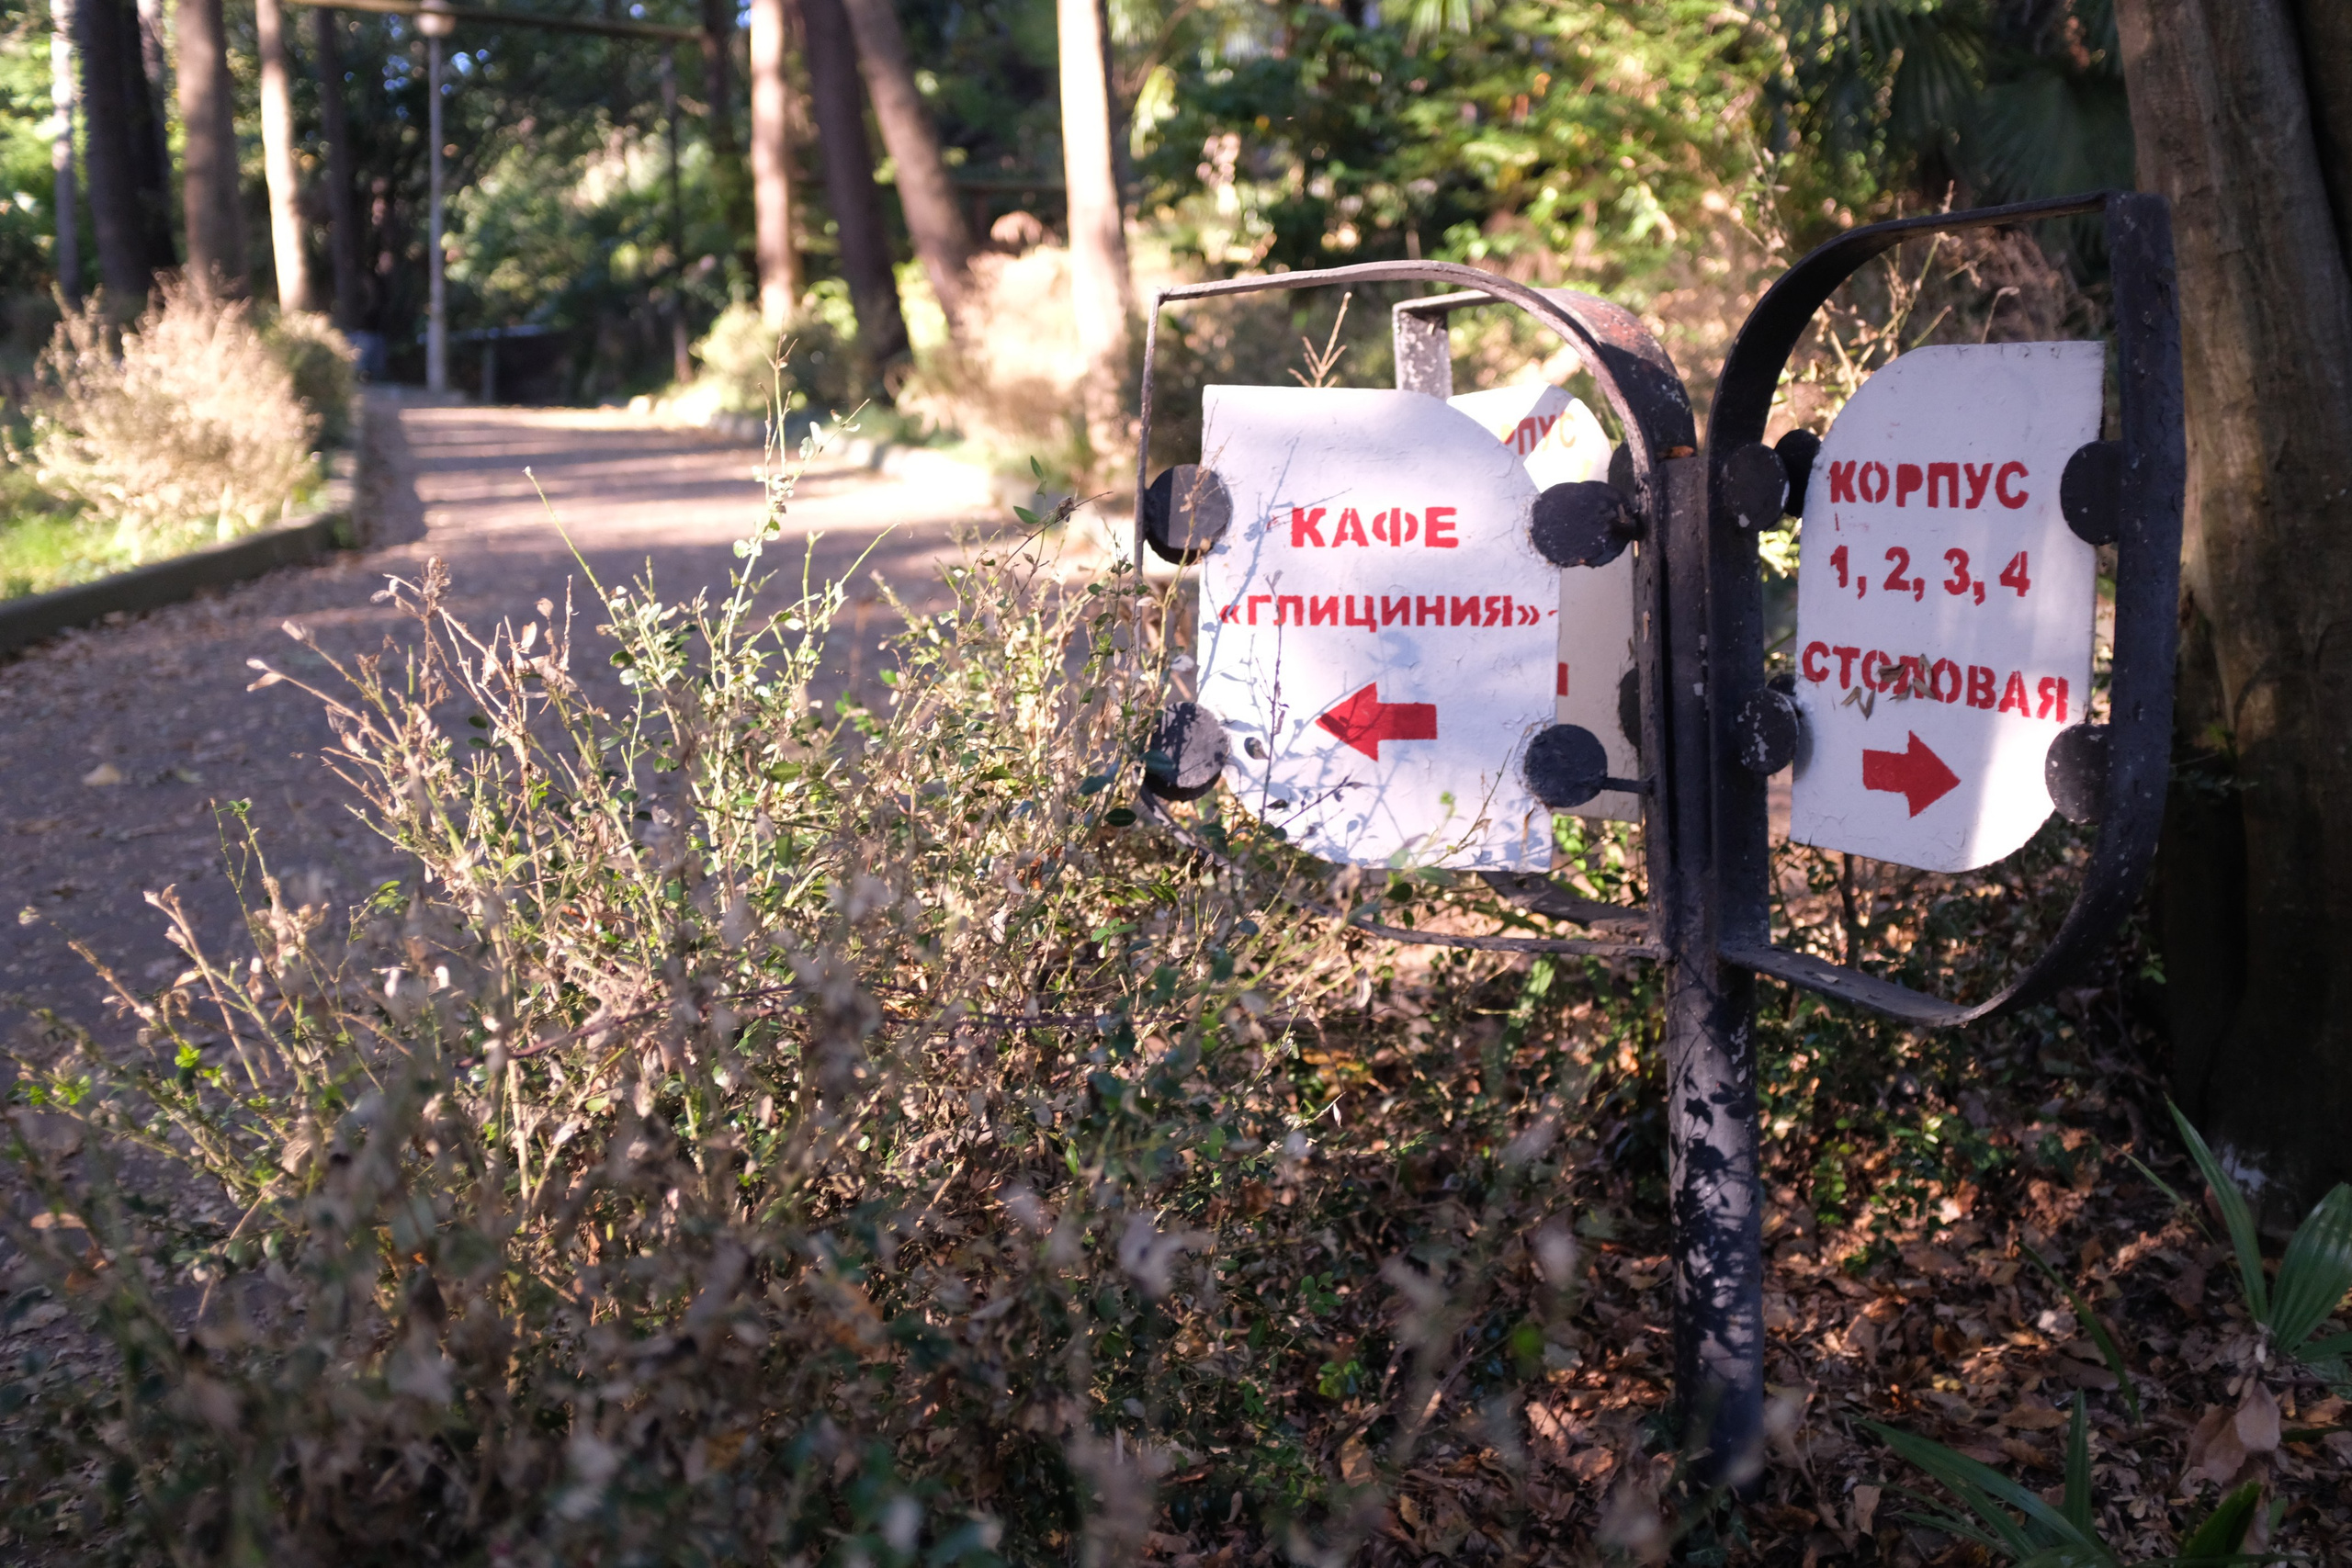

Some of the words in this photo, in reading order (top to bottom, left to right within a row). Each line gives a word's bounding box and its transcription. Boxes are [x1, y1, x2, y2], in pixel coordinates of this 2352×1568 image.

[1828, 459, 2030, 510] КОРПУС
[1290, 505, 1461, 550] КАФЕ
[1217, 593, 1541, 634] «ГЛИЦИНИЯ»
[1801, 640, 2070, 725] СТОЛОВАЯ
